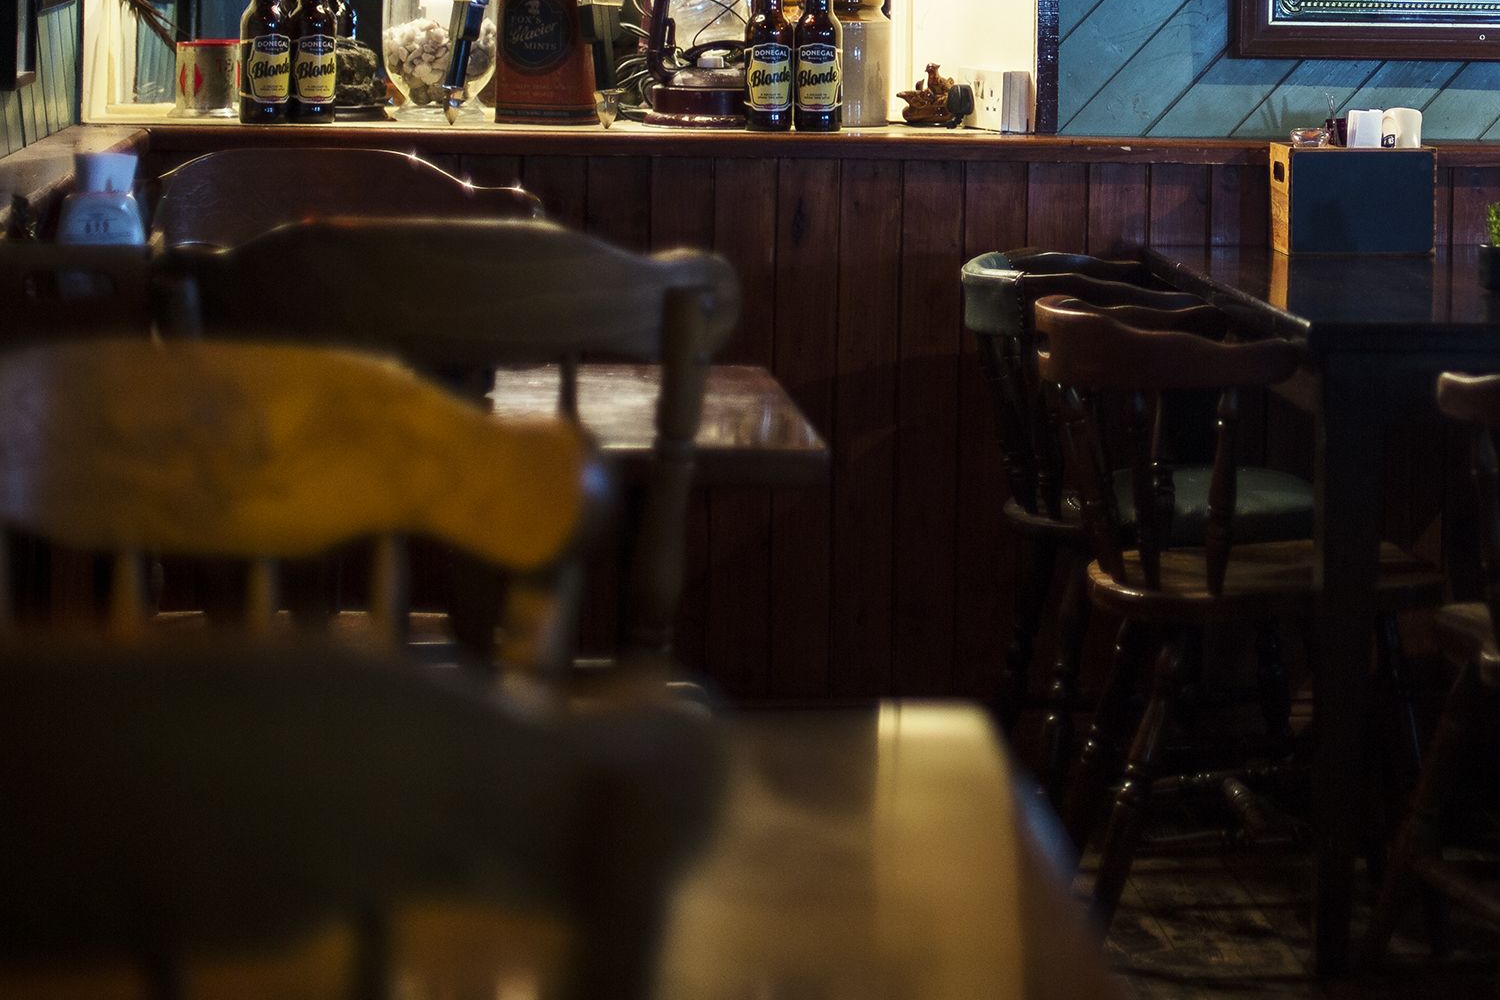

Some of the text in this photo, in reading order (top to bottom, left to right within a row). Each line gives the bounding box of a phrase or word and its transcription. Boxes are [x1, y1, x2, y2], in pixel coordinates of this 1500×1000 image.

[511, 15, 541, 25] FOX'S
[511, 22, 558, 44] Glacier
[523, 42, 557, 50] MINTS
[754, 49, 787, 57] DONEGAL
[801, 49, 834, 57] DONEGAL
[750, 66, 791, 88] Blonde
[799, 66, 838, 88] Blonde
